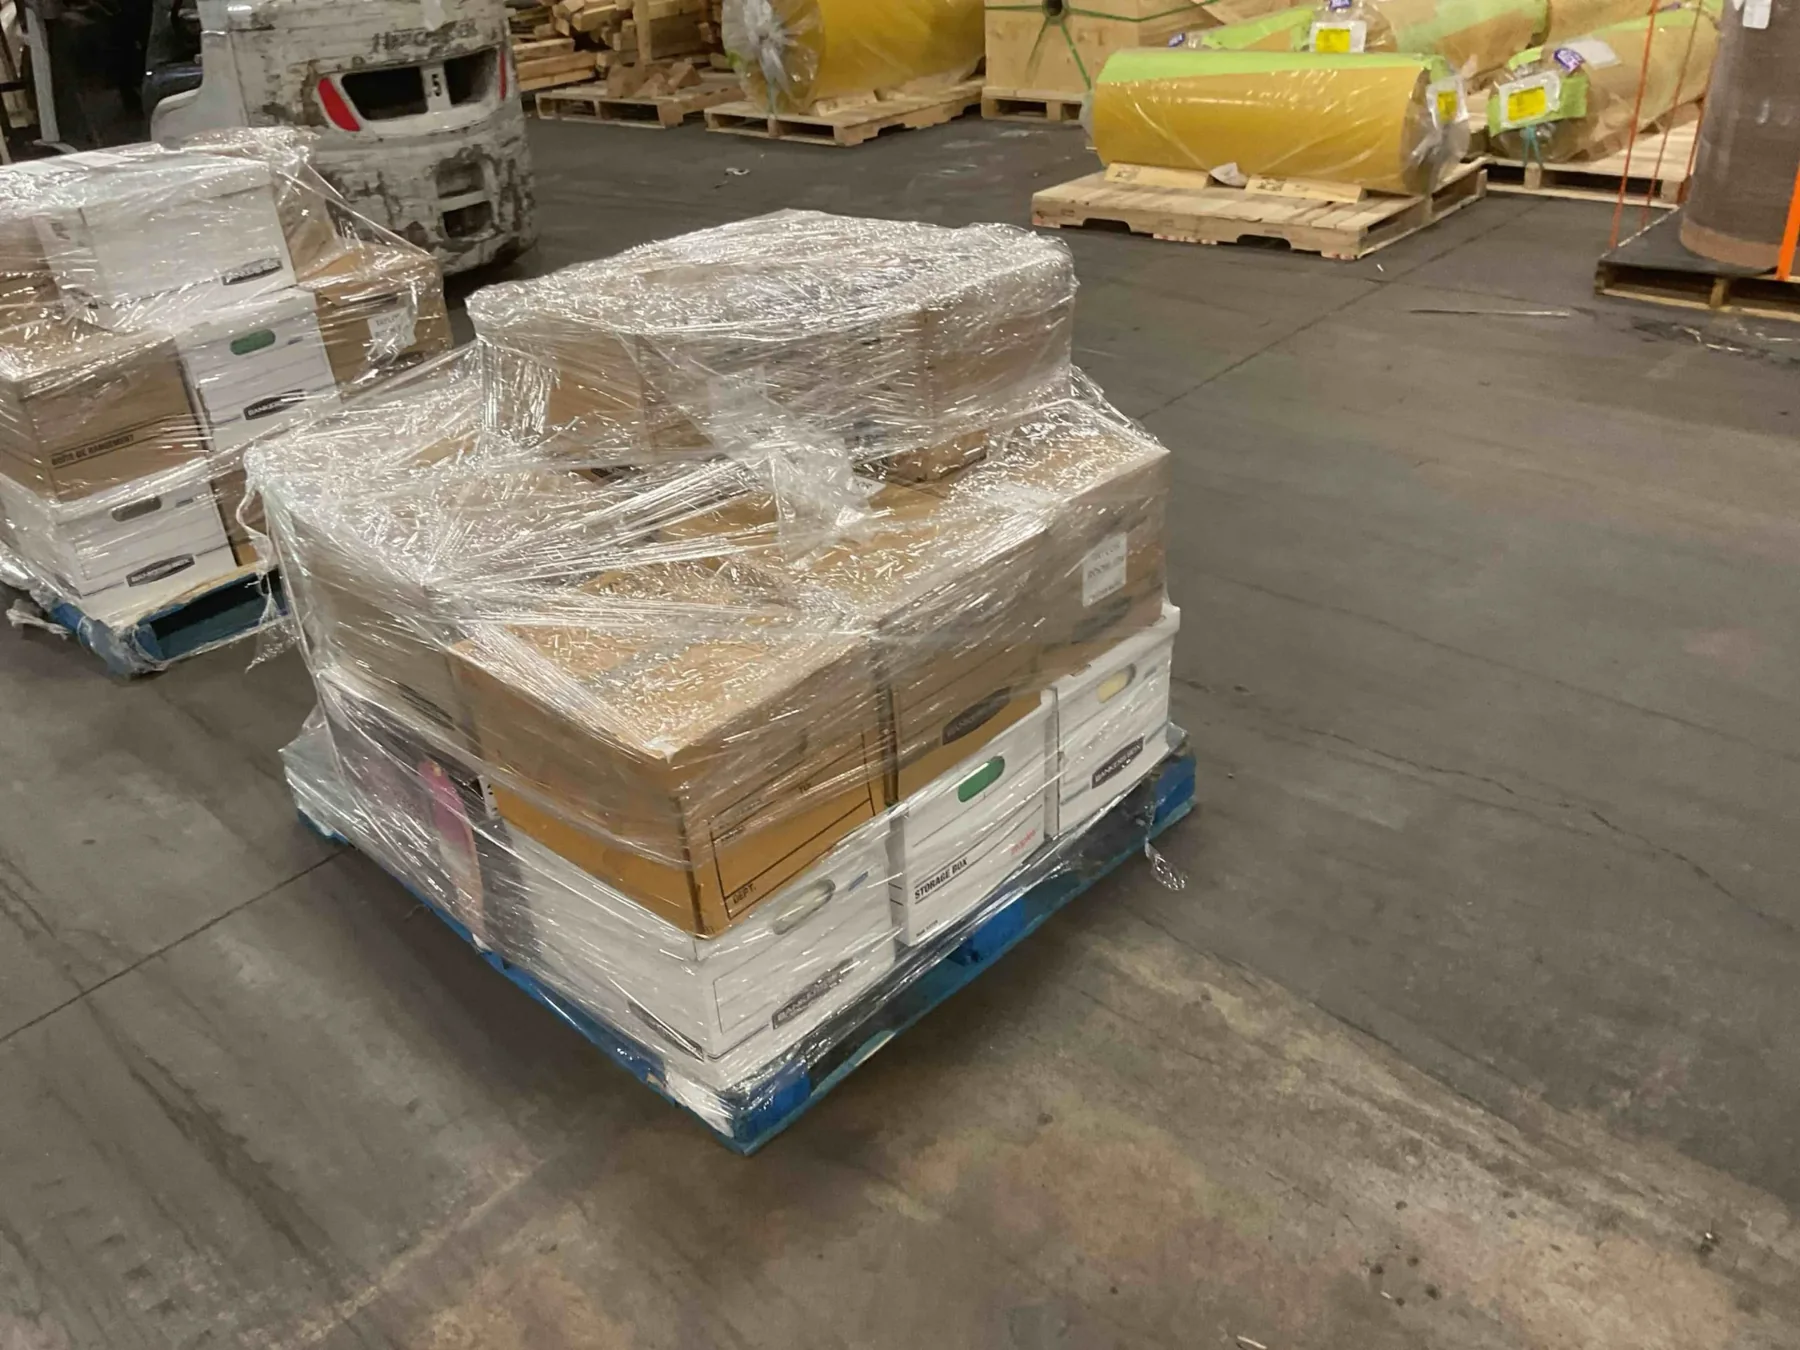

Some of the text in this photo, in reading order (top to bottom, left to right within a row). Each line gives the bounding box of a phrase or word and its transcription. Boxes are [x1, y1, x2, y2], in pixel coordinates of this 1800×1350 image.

[431, 74, 442, 97] 5
[247, 399, 285, 416] BANKE
[914, 856, 968, 900] STORAGE BOX
